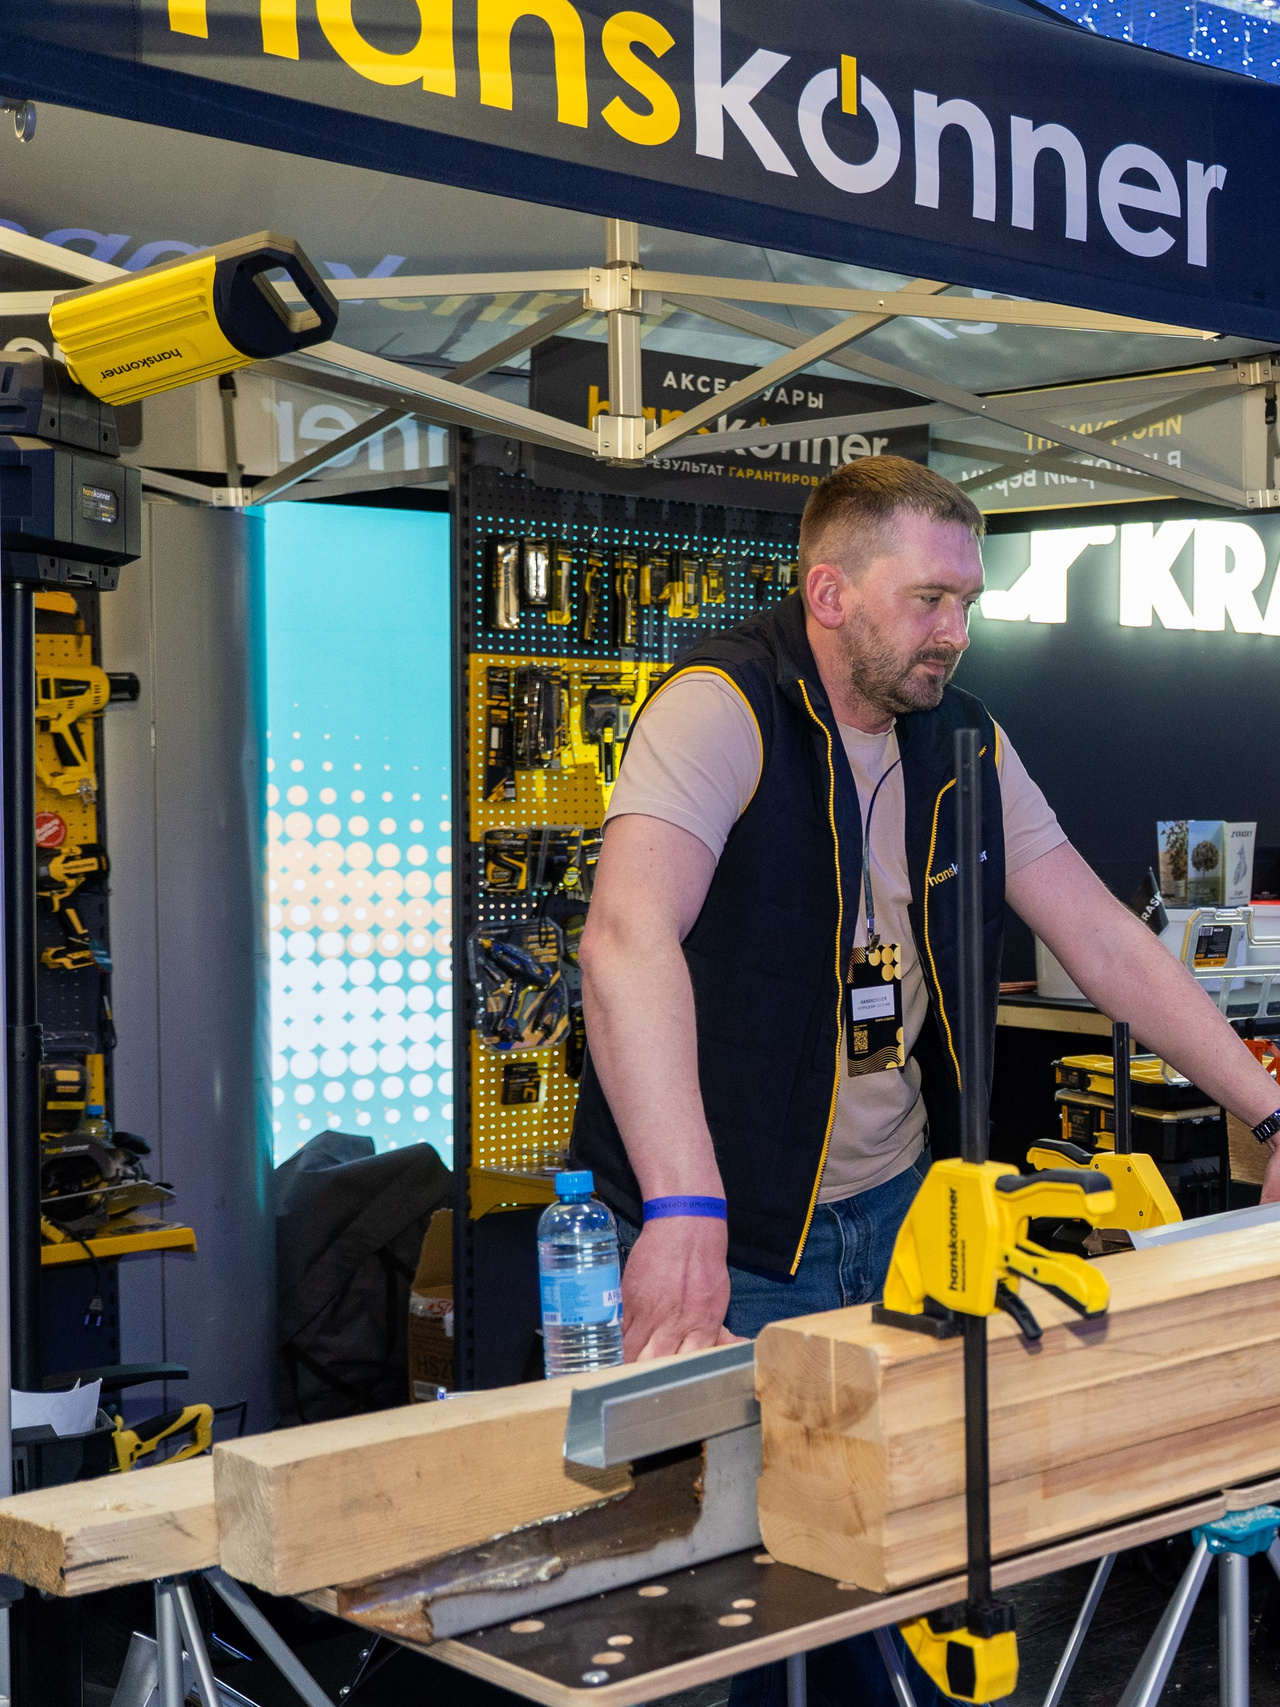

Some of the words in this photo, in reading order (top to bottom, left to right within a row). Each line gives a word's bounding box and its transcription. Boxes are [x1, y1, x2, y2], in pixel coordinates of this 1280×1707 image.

[167, 0, 1228, 268] anskonner
[101, 349, 183, 381] hanskonner
[663, 371, 824, 409] АКСЕУАРЫ
[653, 459, 725, 476] ЕЗУЛЬТАТ
[729, 467, 825, 487] ГАРАНТИРОВ
[929, 850, 988, 887] hansker
[948, 1186, 958, 1292] hanskonner
